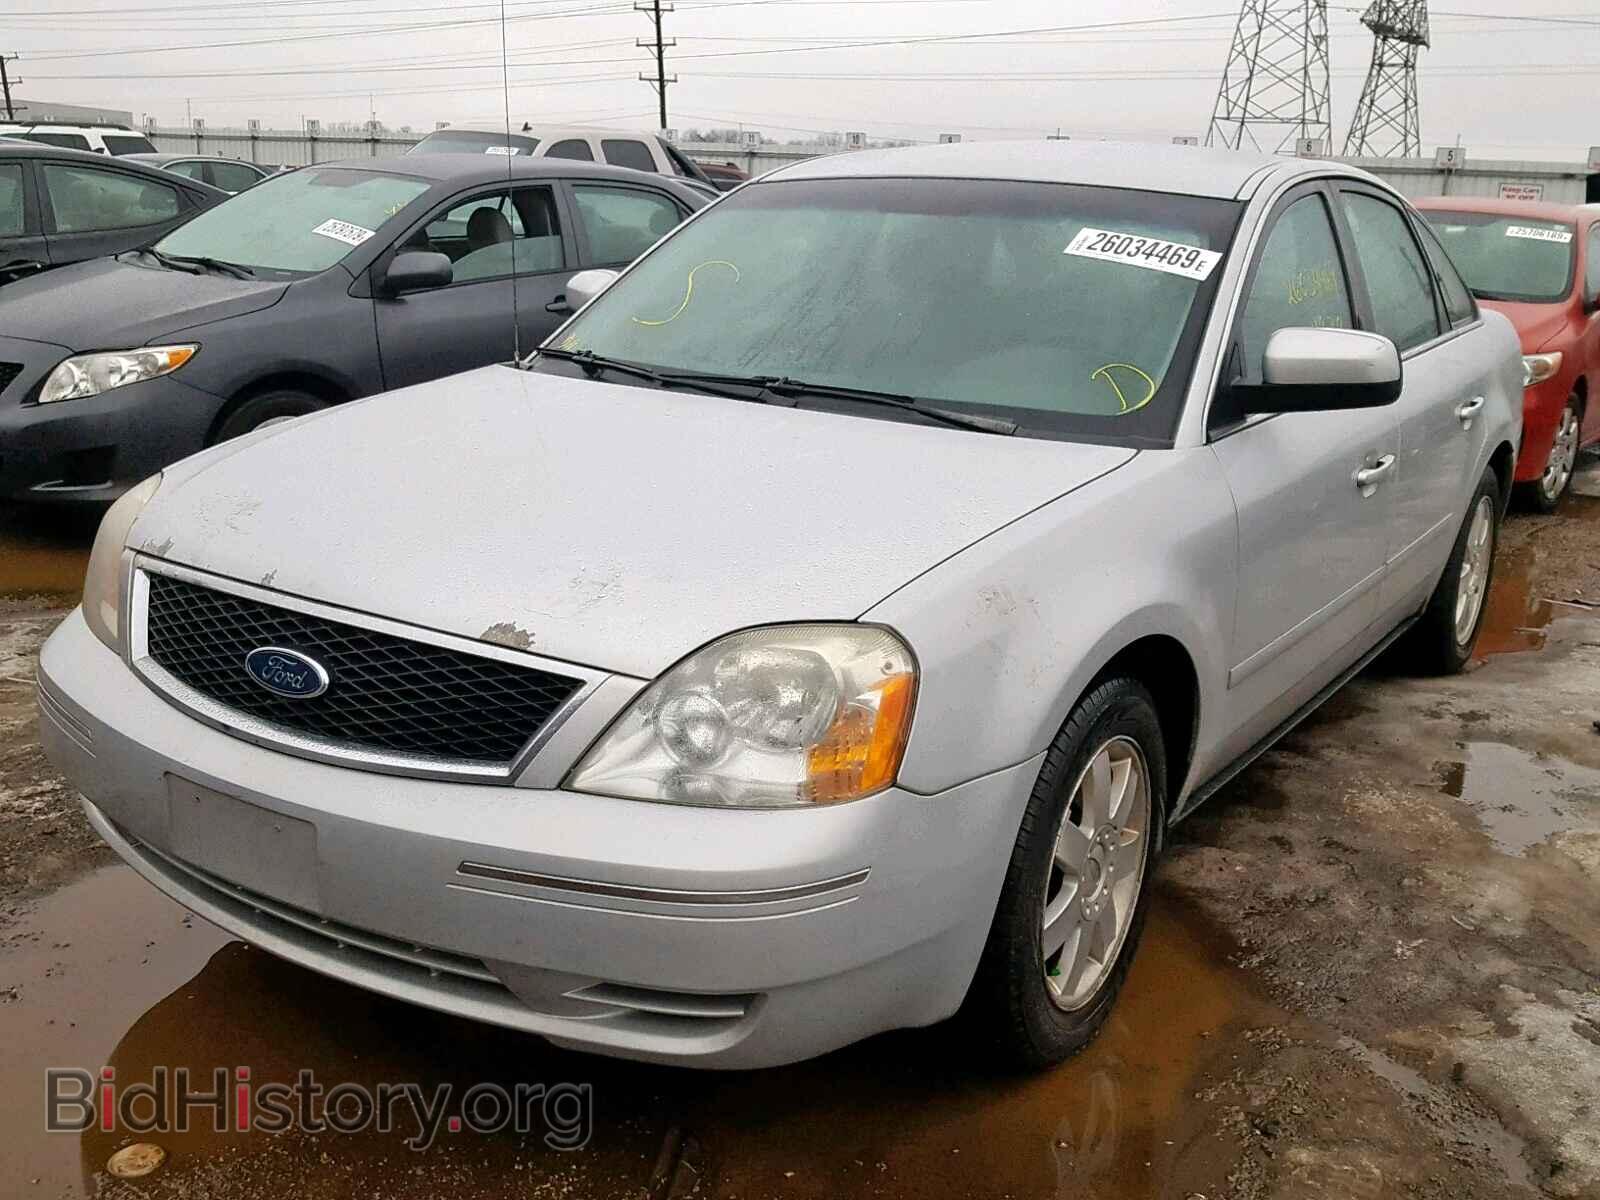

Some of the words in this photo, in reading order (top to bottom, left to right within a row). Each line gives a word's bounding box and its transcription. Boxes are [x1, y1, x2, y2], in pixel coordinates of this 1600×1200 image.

[1305, 141, 1313, 151] 6
[1447, 150, 1454, 161] 5
[1091, 363, 1155, 416] D
[262, 655, 309, 689] Ford
